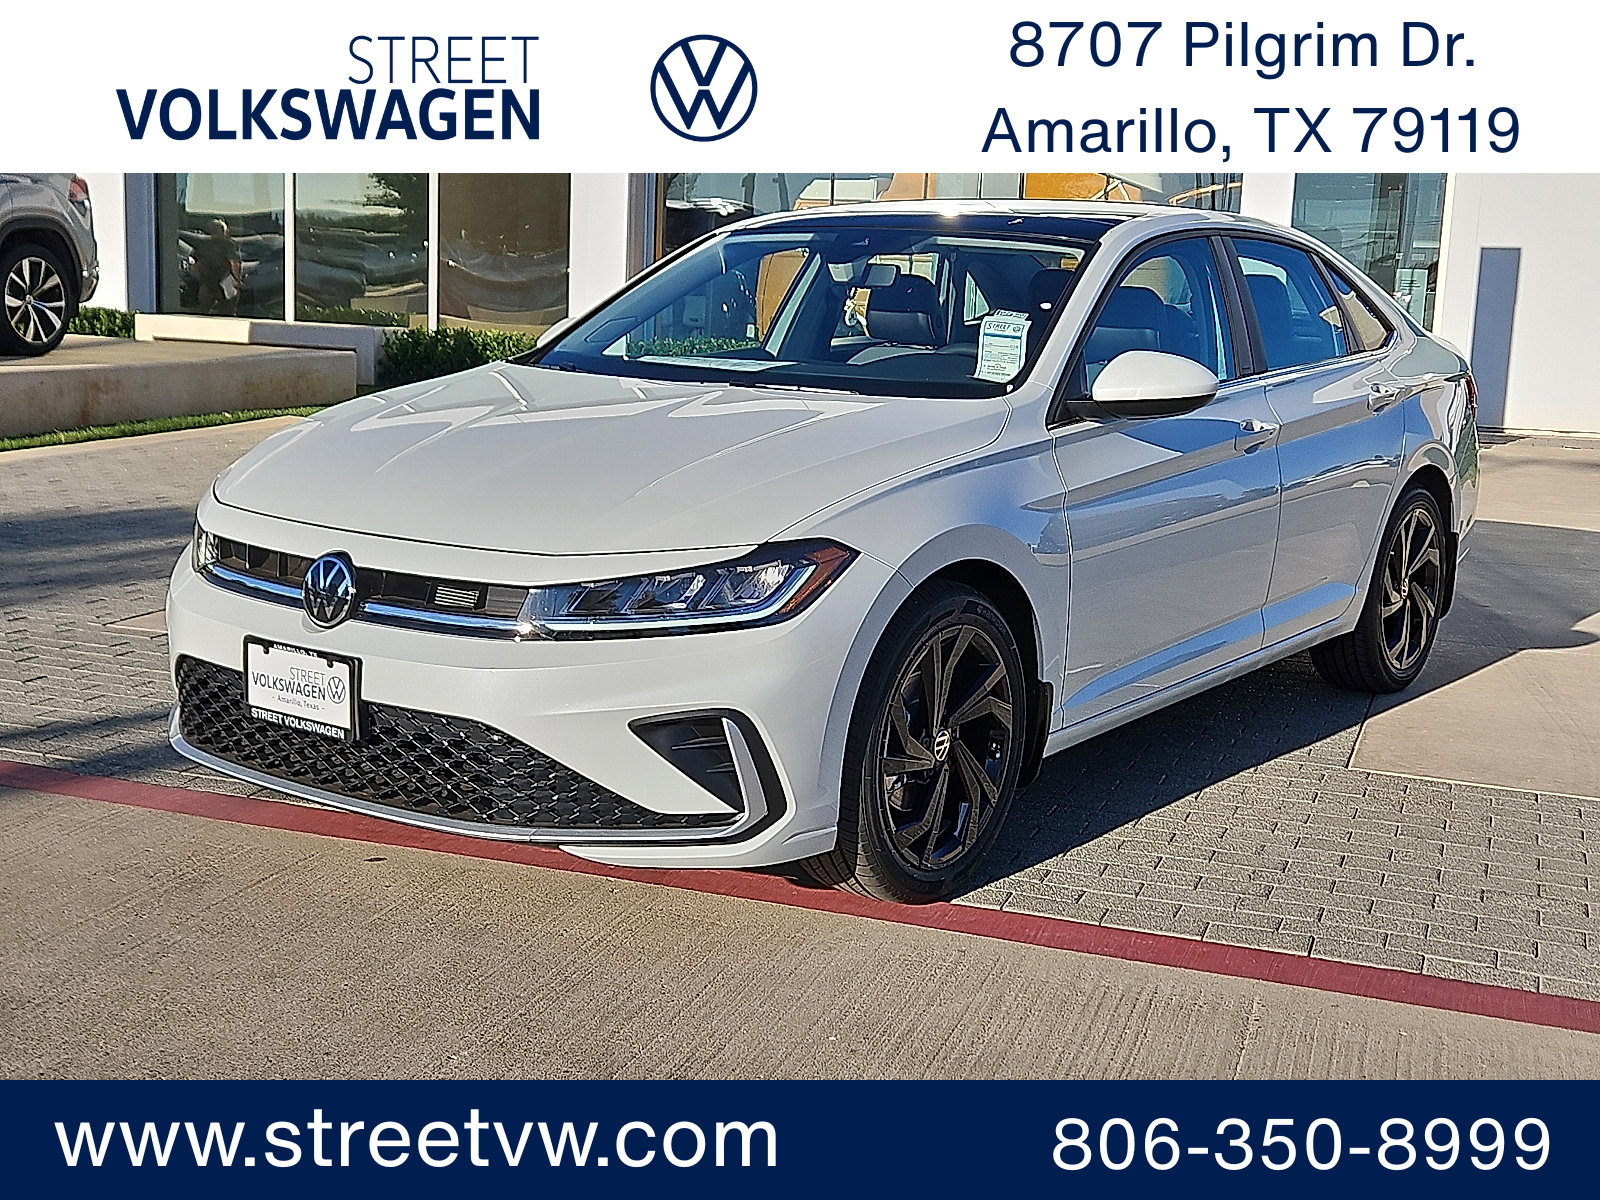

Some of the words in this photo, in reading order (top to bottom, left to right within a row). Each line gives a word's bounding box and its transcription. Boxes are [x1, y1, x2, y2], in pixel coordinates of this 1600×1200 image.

[251, 671, 326, 701] VOLKSWAGEN
[289, 666, 326, 686] STREET
[276, 694, 303, 708] Amarillo,
[303, 700, 320, 711] Texas
[250, 707, 284, 725] STREET
[284, 716, 345, 740] VOLKSWAGEN
